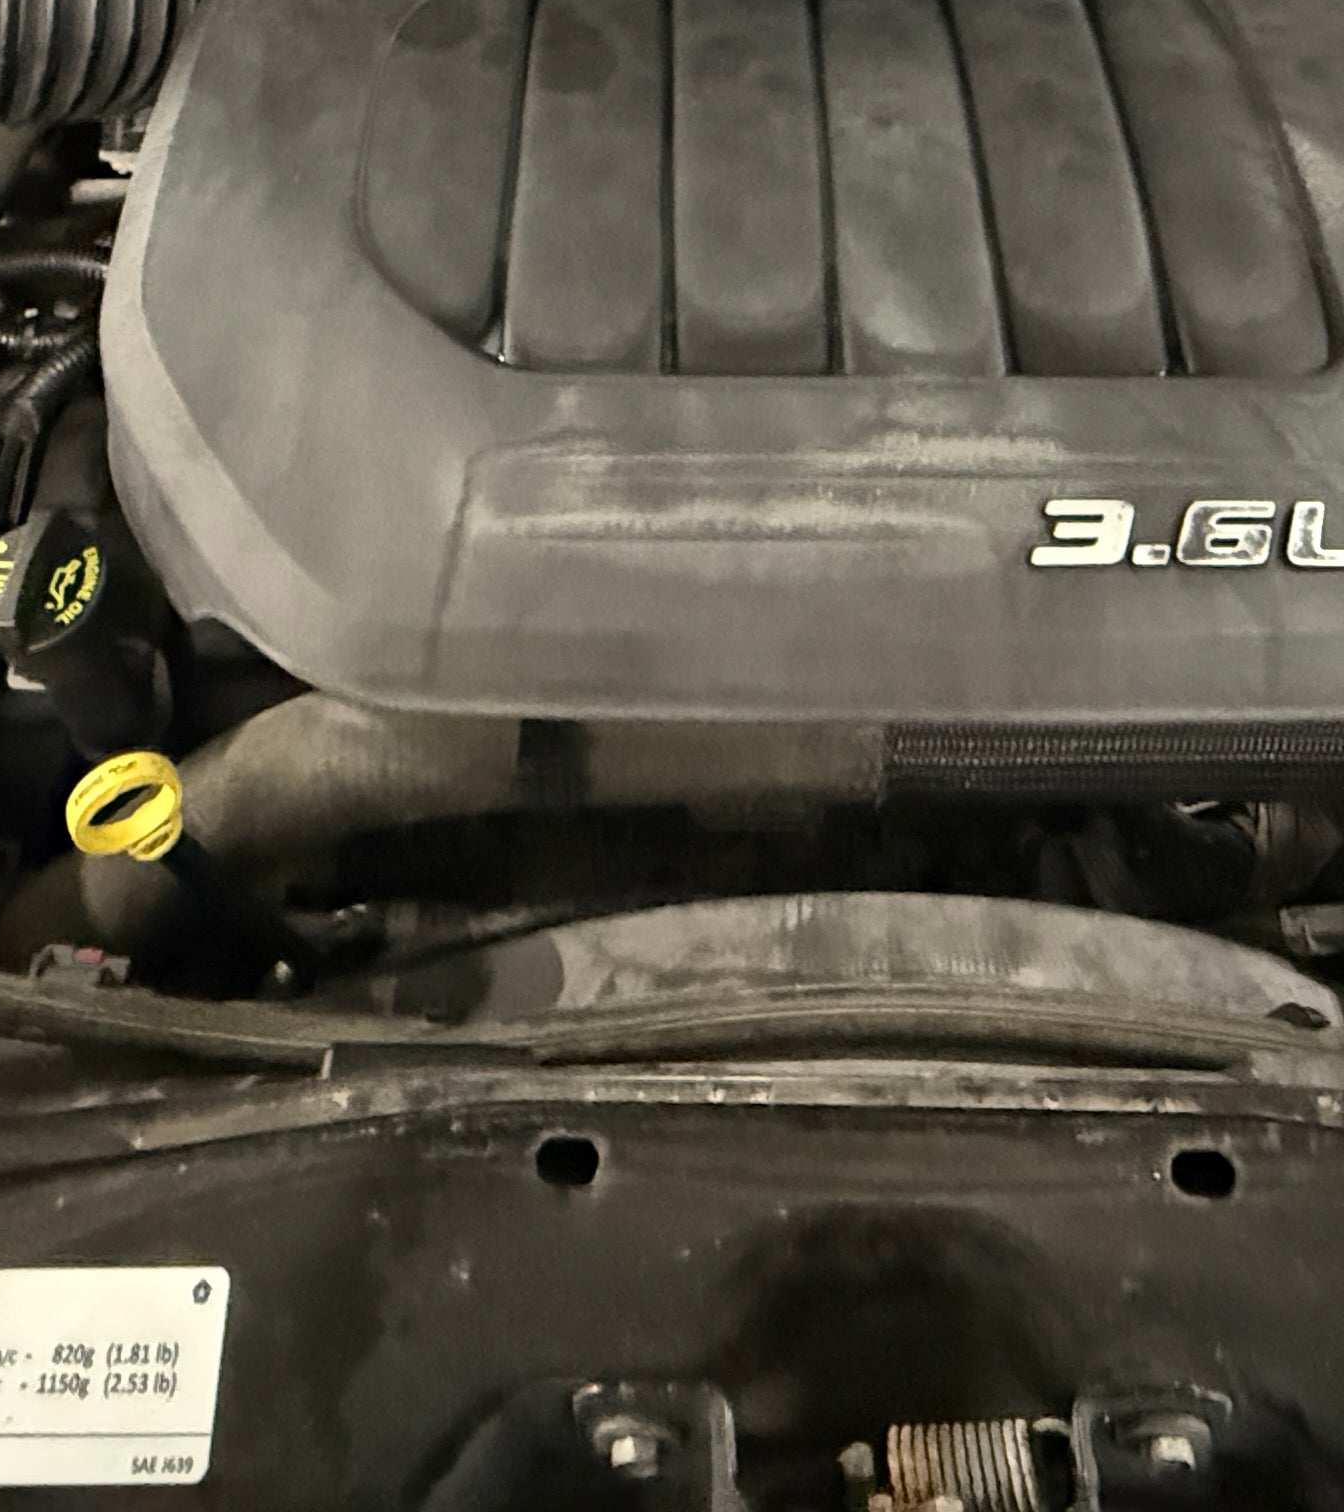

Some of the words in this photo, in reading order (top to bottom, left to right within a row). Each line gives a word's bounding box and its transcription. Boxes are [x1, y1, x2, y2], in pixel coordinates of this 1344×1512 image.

[52, 1343, 95, 1369] 820g
[106, 1342, 150, 1369] (1.81
[155, 1341, 179, 1369] lb)
[35, 1372, 90, 1400] 1150g
[103, 1372, 149, 1399] (2.53
[153, 1371, 177, 1399] lb)
[131, 1456, 157, 1474] SAE
